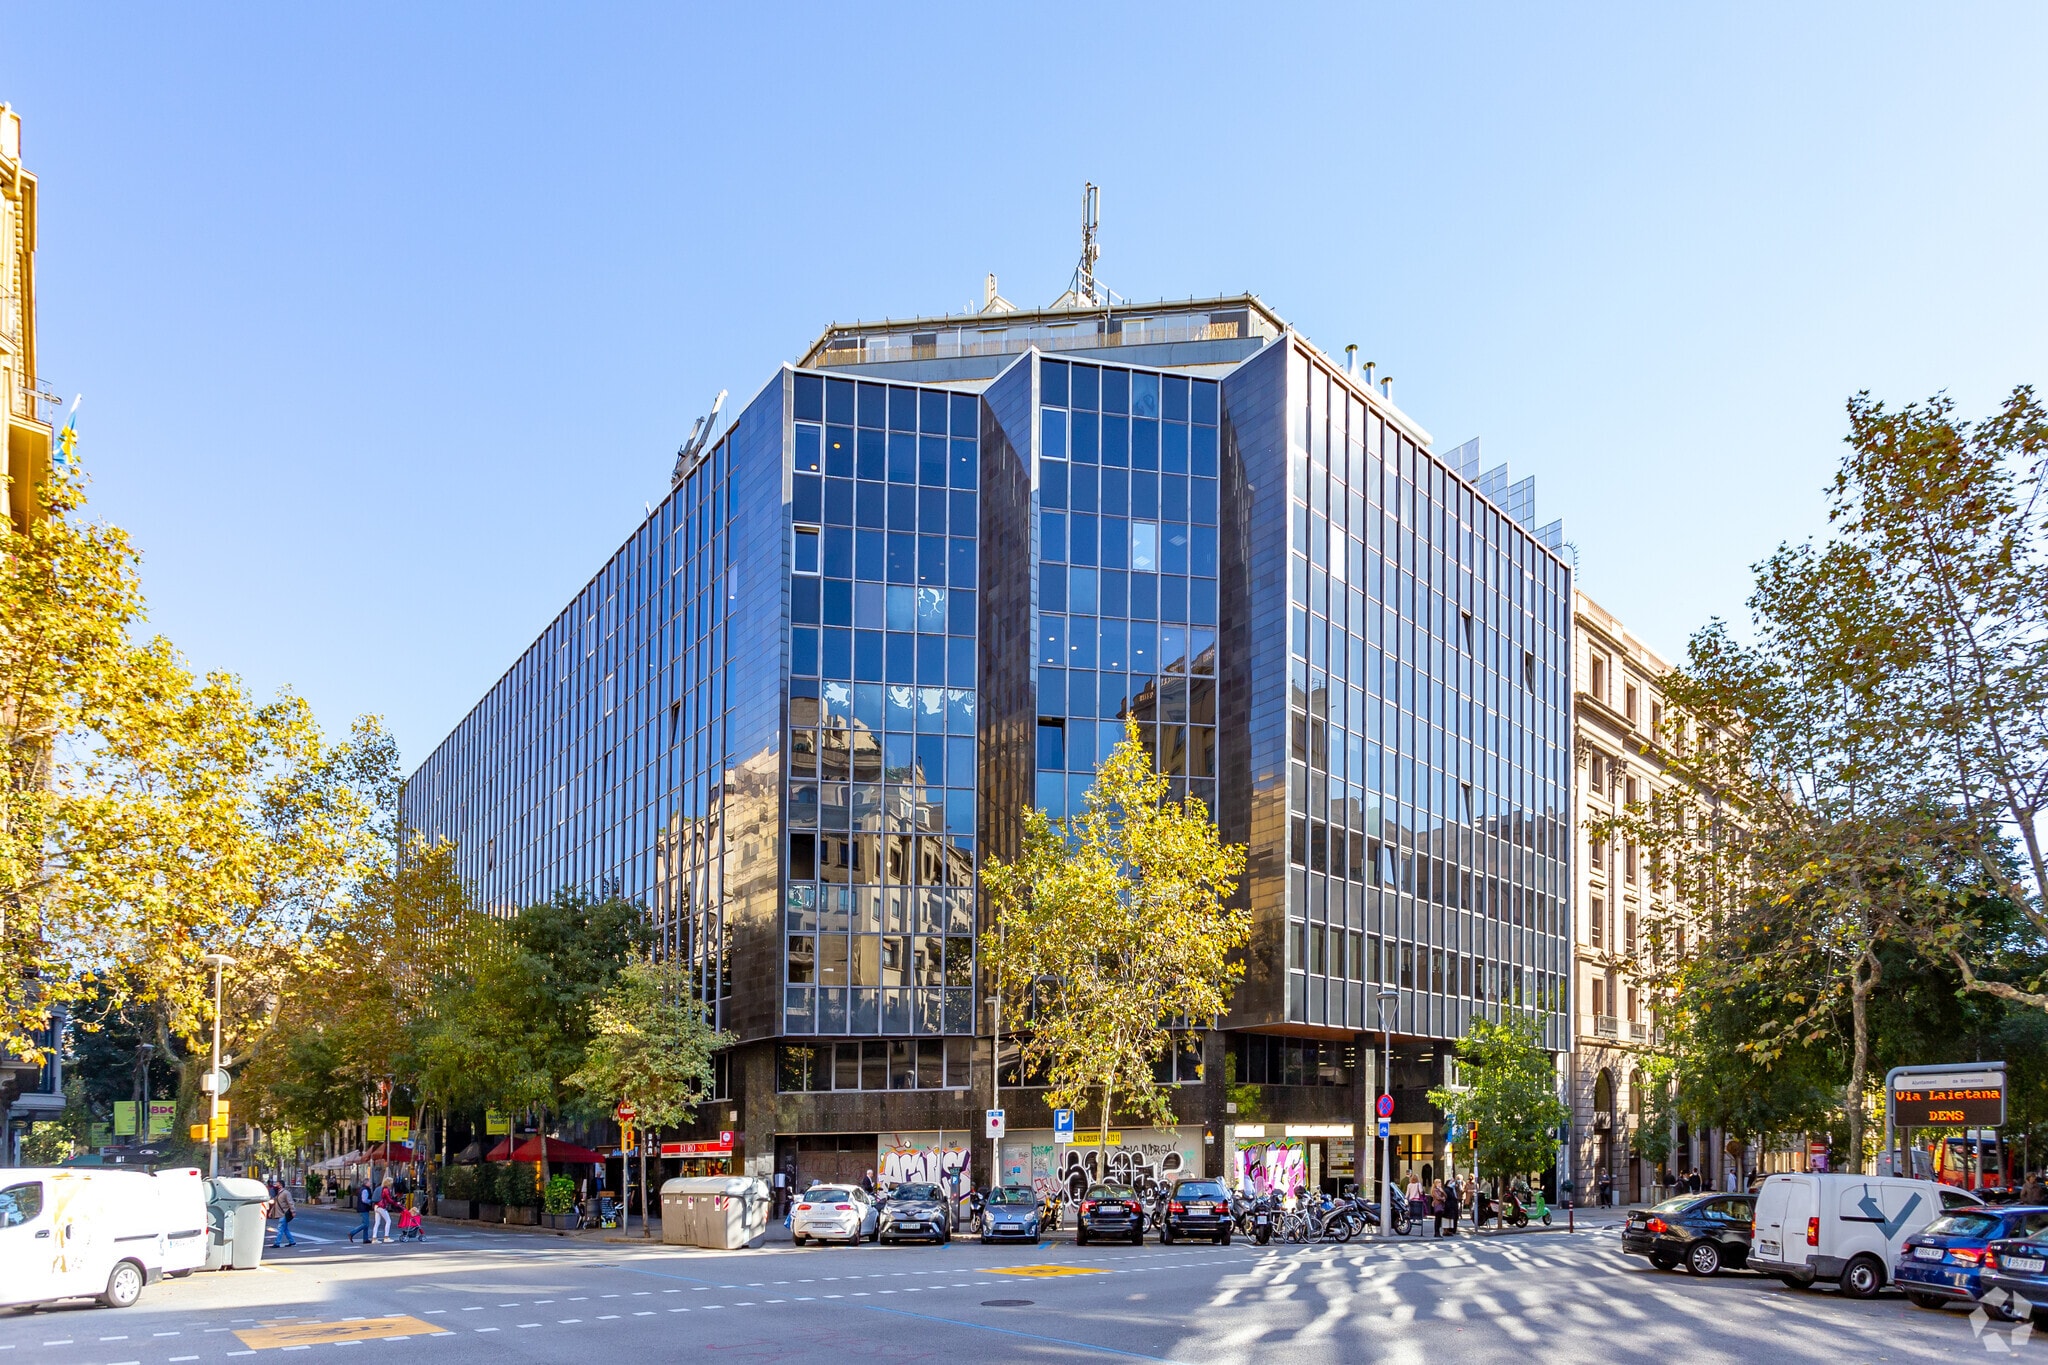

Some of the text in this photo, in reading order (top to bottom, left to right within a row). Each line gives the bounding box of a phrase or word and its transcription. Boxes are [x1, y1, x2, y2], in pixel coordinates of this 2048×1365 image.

[1895, 1089, 2001, 1101] Via Laietana
[150, 1106, 174, 1114] BDC
[1928, 1110, 1965, 1121] DENS
[1058, 1112, 1070, 1130] P
[680, 1143, 696, 1153] EURO
